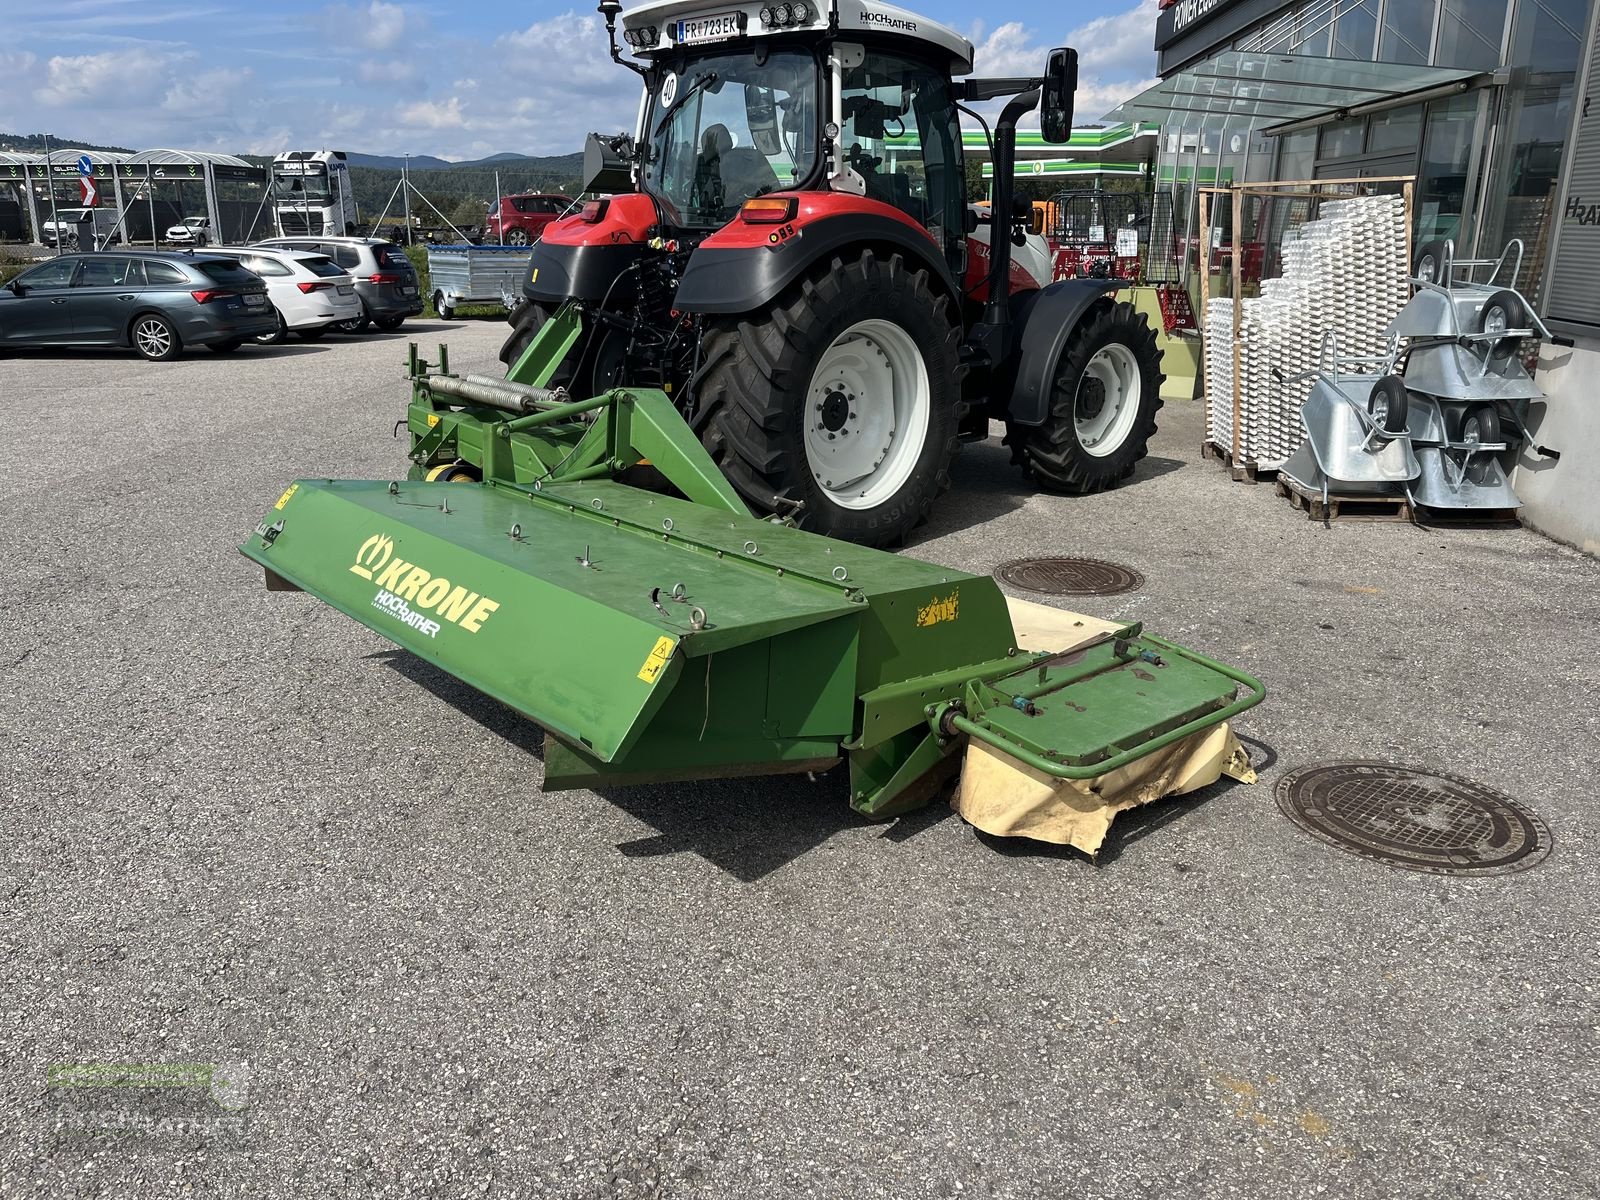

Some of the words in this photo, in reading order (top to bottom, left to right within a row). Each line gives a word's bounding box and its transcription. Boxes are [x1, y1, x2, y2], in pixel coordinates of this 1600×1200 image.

[685, 23, 697, 39] FR
[860, 12, 917, 32] HOCHRATHER
[663, 79, 674, 102] 40
[374, 557, 500, 634] KRONE
[374, 588, 441, 639] HOCHRATHER
